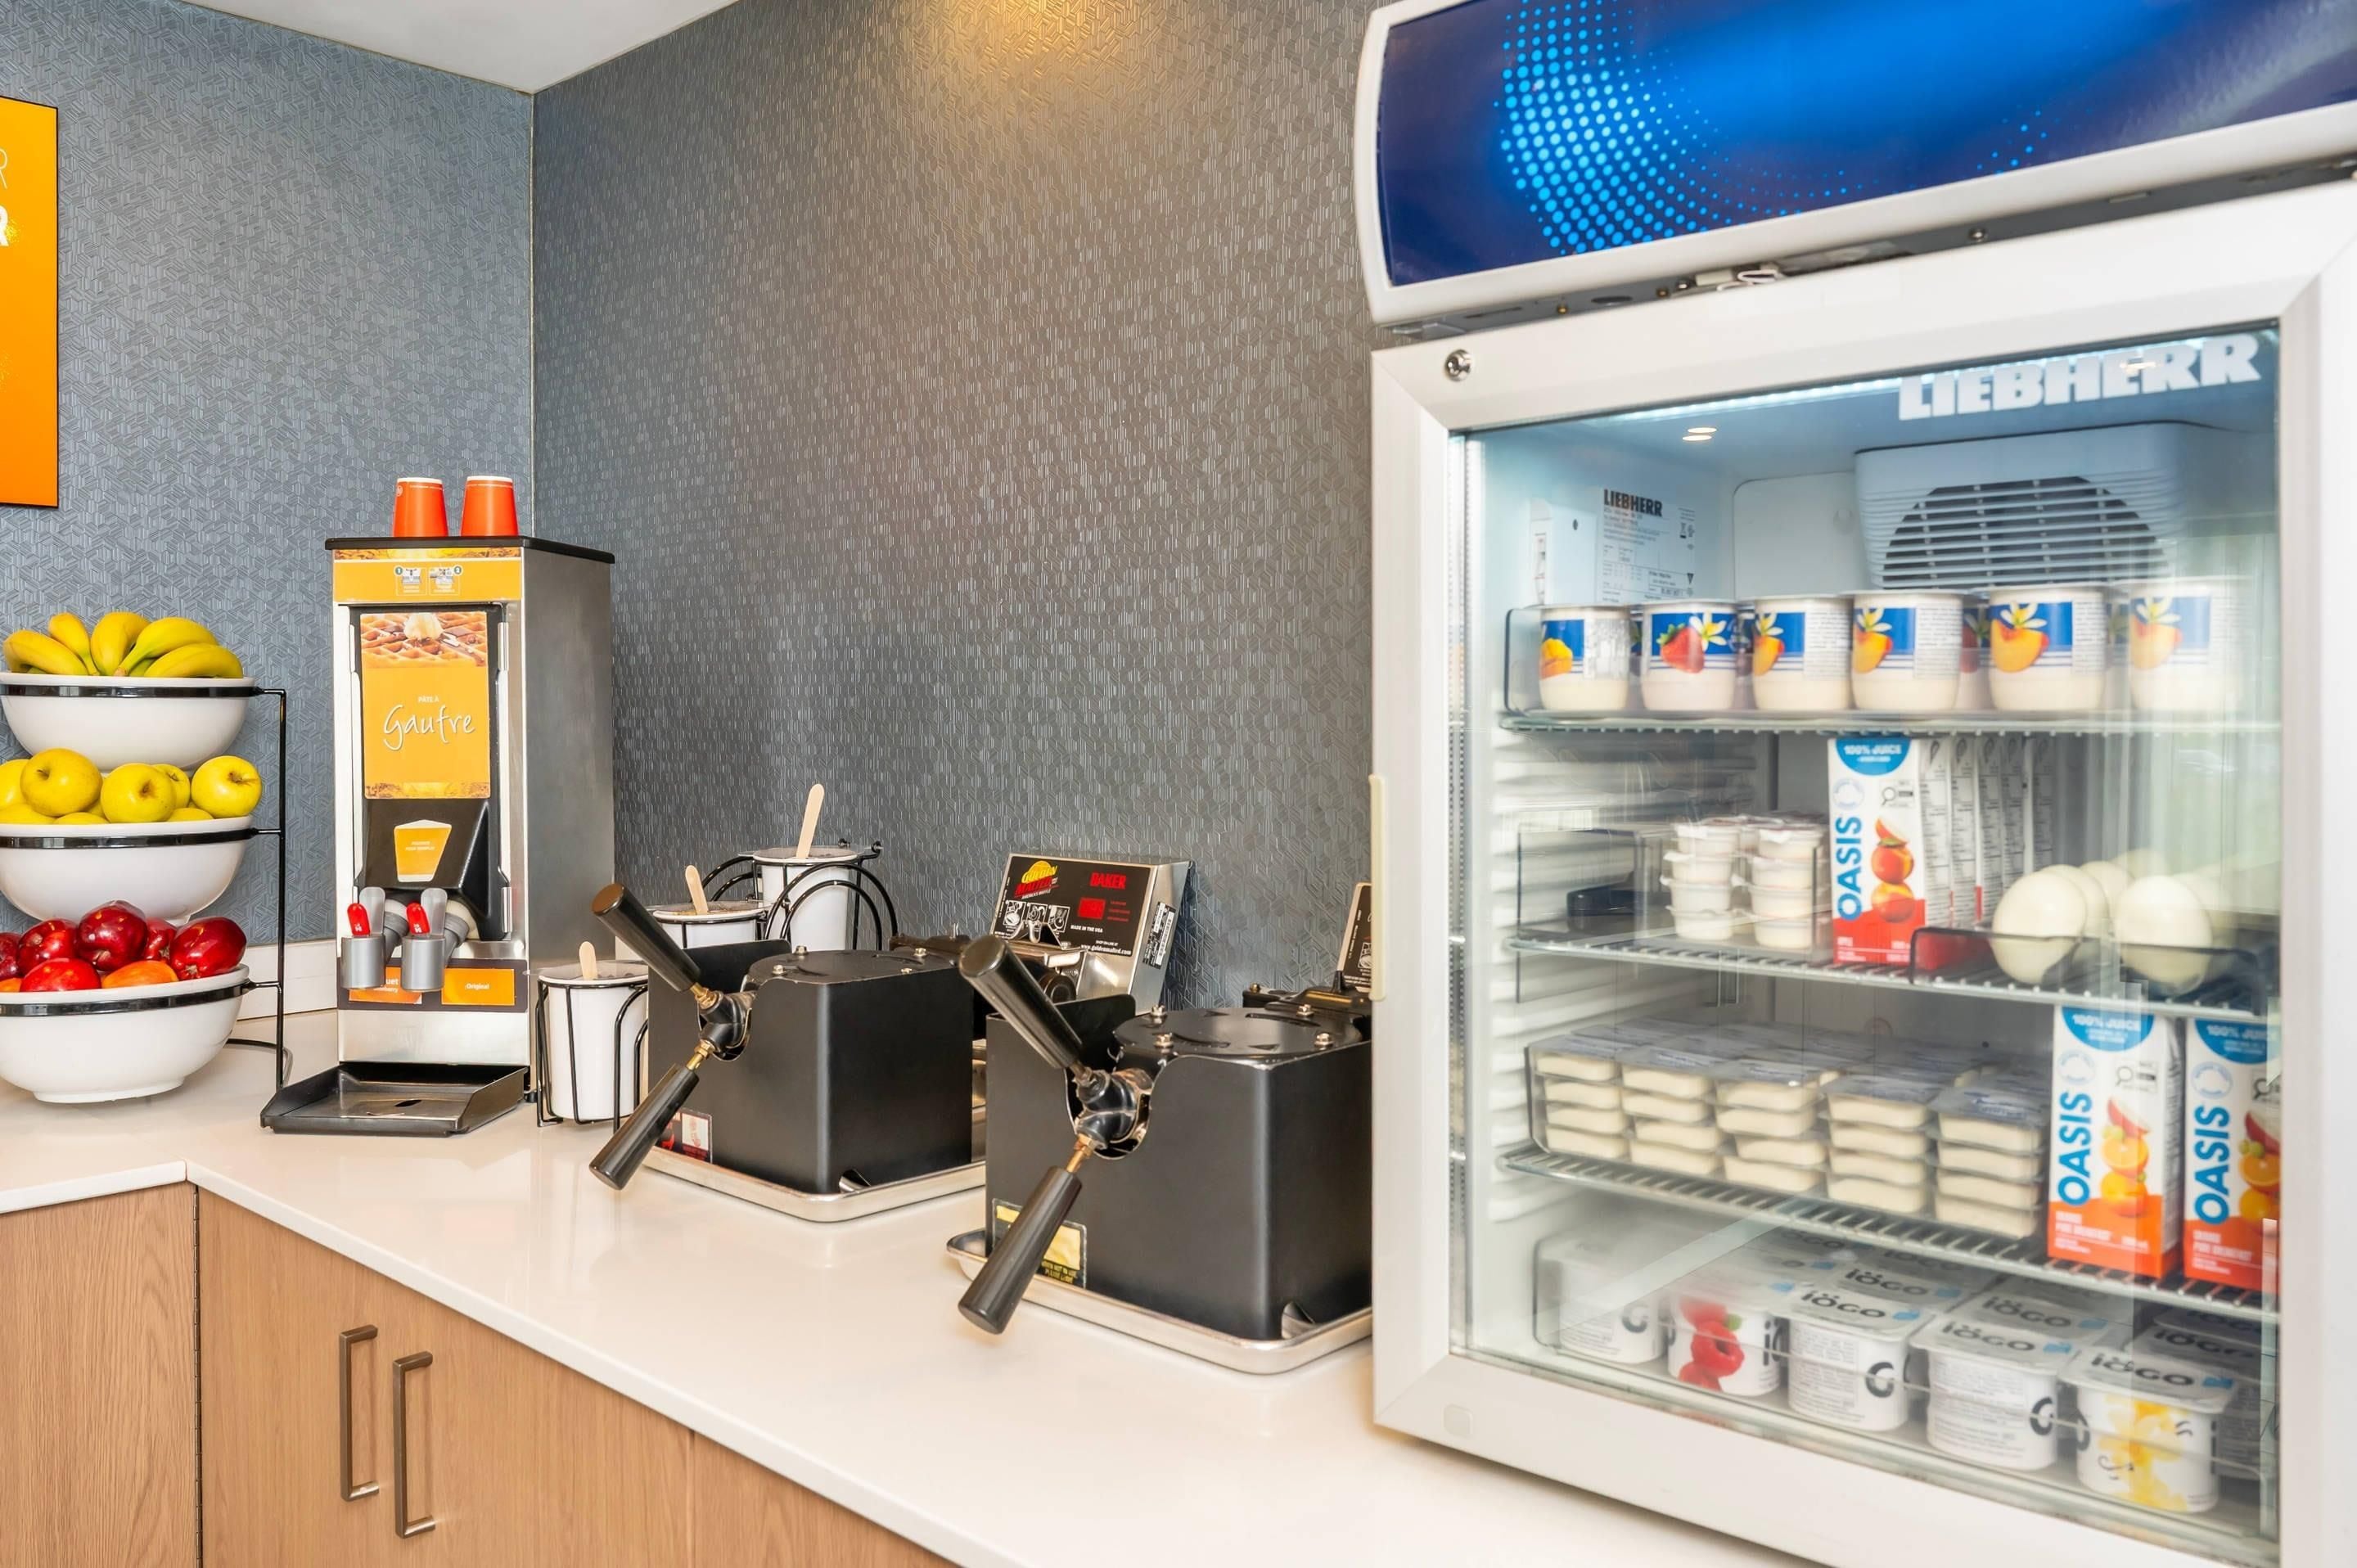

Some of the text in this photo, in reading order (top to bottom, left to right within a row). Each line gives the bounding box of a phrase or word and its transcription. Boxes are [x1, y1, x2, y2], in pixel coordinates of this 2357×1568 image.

[1899, 333, 2260, 420] LIEBHERR
[1604, 489, 1663, 517] LIEBHERR
[383, 705, 475, 751] Gaufre
[1089, 872, 1127, 890] BAKER
[1835, 816, 1863, 921] OASIS
[2057, 1090, 2093, 1206] OASIS
[2194, 1104, 2230, 1225] OASIS
